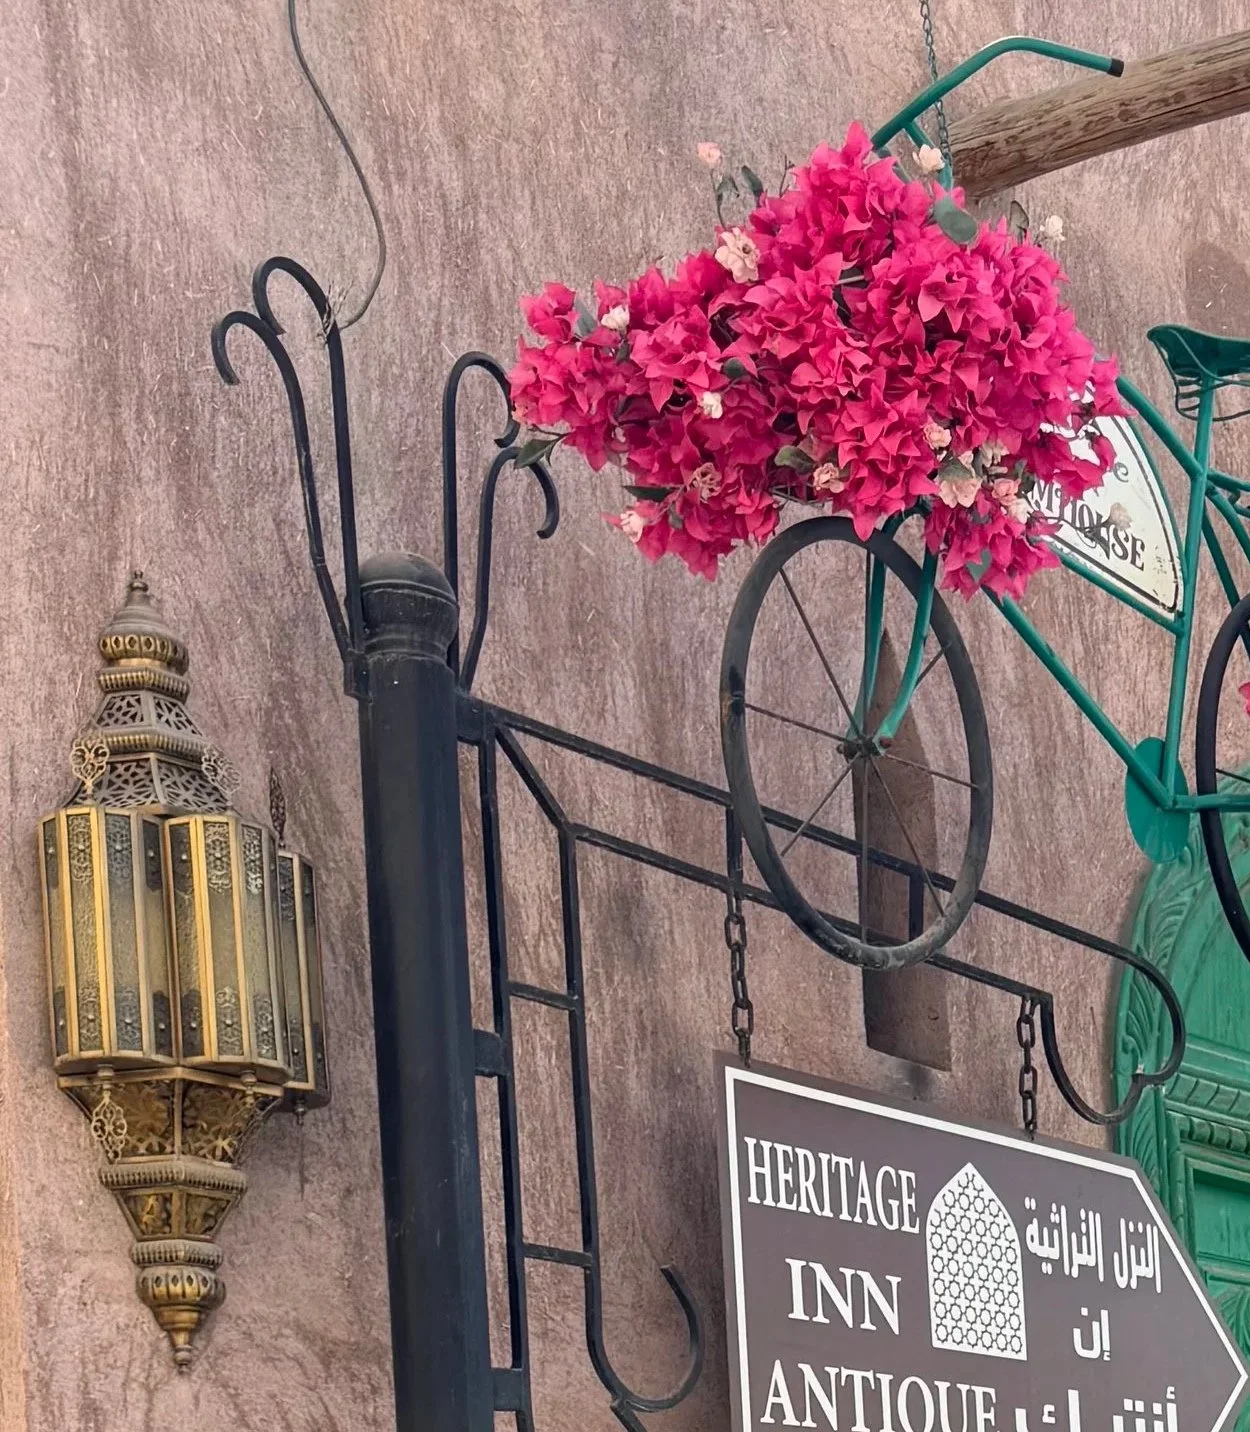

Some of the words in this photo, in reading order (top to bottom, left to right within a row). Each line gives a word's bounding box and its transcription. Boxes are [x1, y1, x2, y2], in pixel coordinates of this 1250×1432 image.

[743, 1136, 920, 1234] HERITAGE
[1024, 1196, 1105, 1283] التراثية
[1113, 1217, 1162, 1294] النزل
[784, 1257, 902, 1335] INN
[1072, 1306, 1111, 1362] إن
